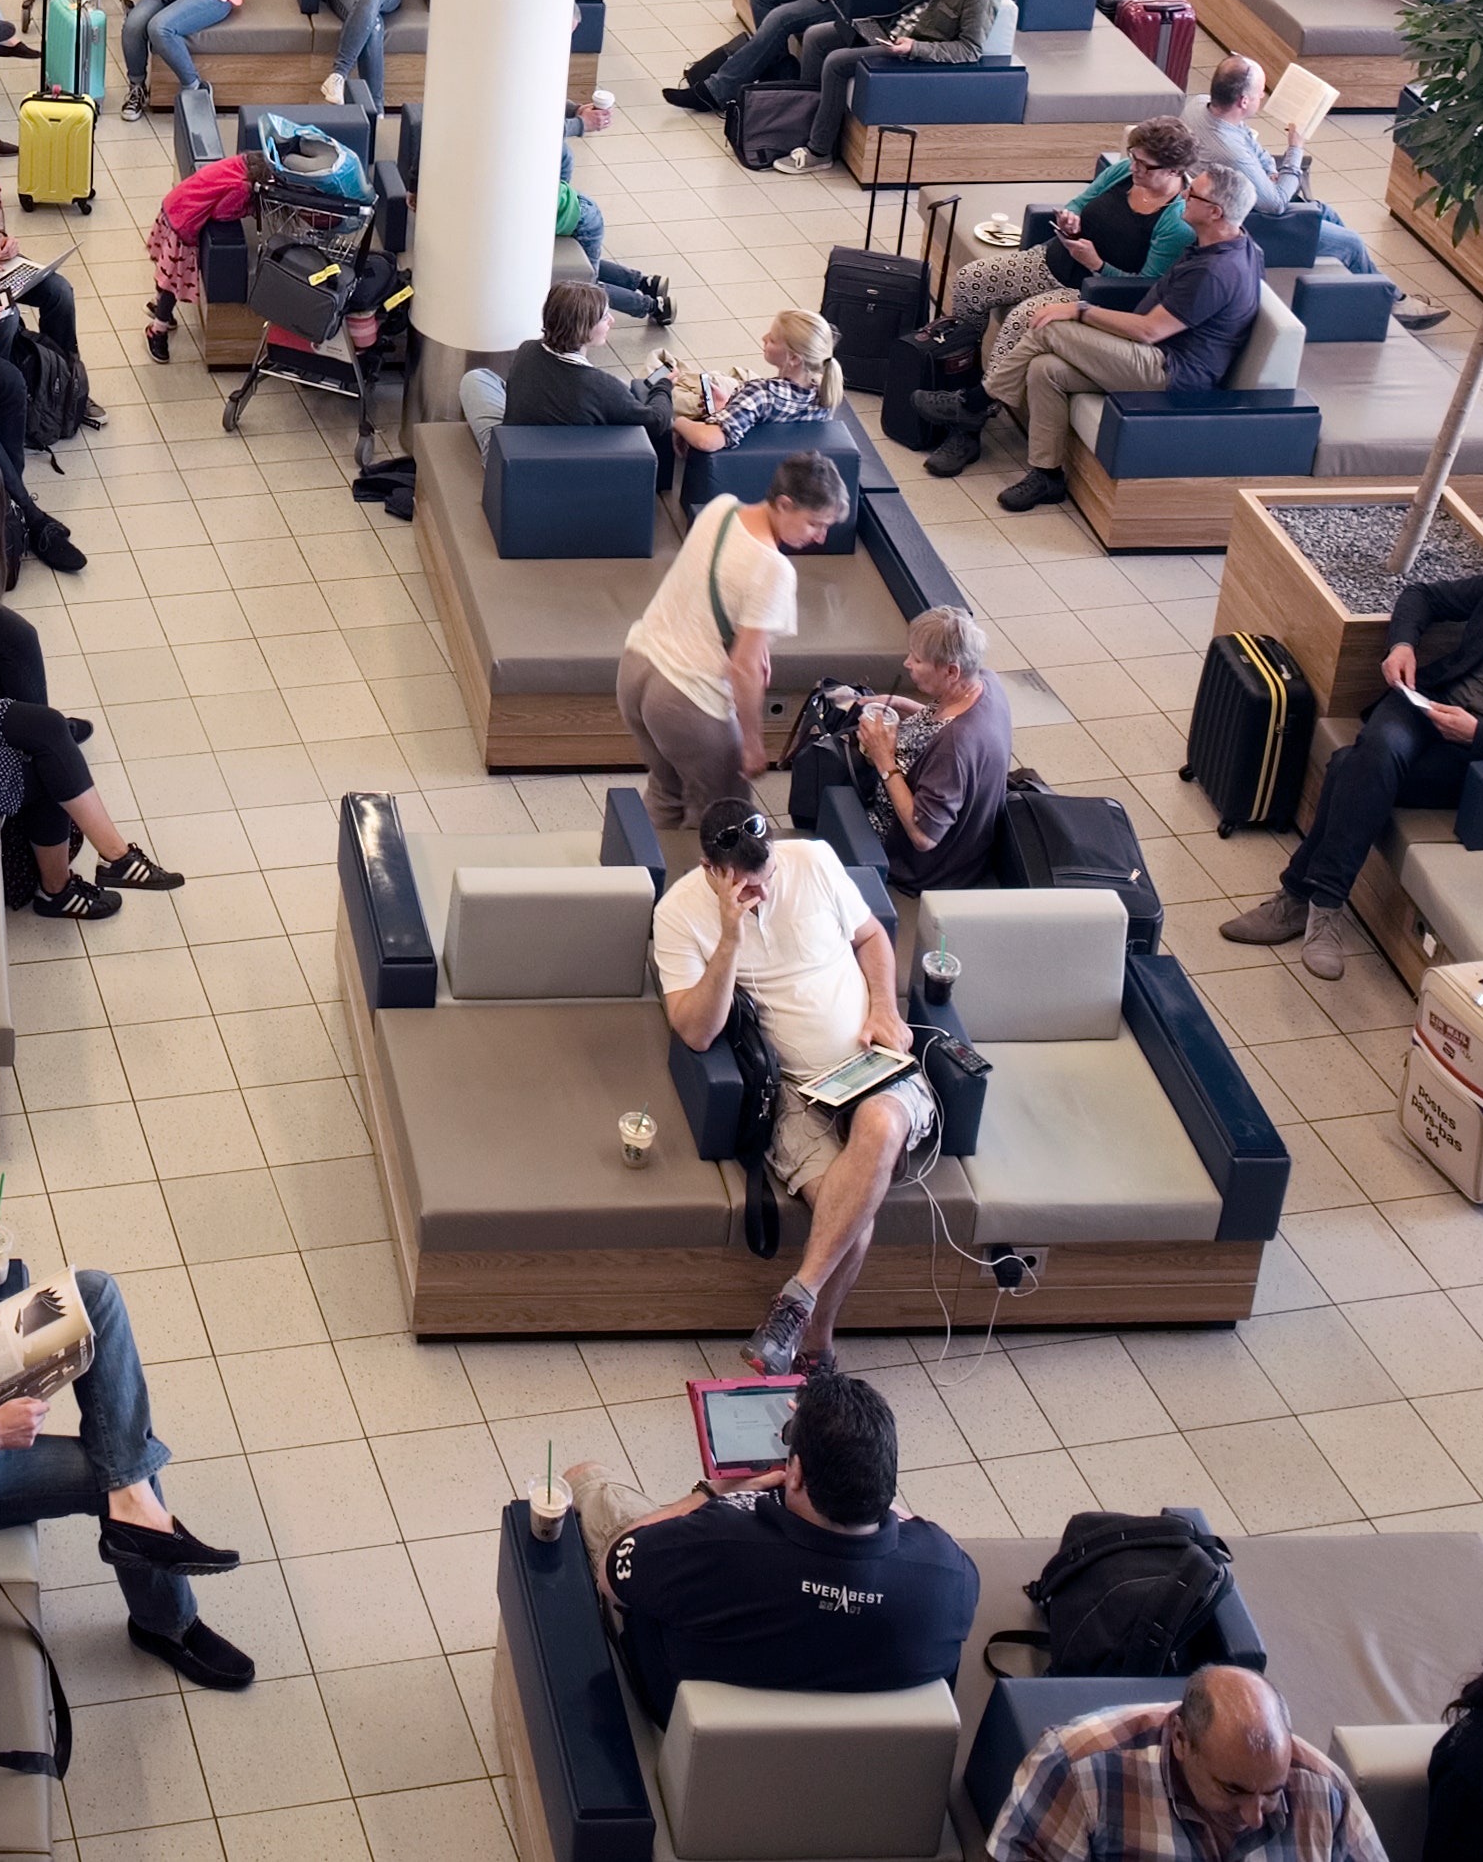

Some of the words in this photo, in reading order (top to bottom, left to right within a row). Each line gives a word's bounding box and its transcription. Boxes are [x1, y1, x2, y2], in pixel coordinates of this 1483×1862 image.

[1411, 1094, 1462, 1152] pays-bas
[1418, 1084, 1456, 1130] postes
[802, 1580, 840, 1599] EVER
[848, 1590, 884, 1605] BEST
